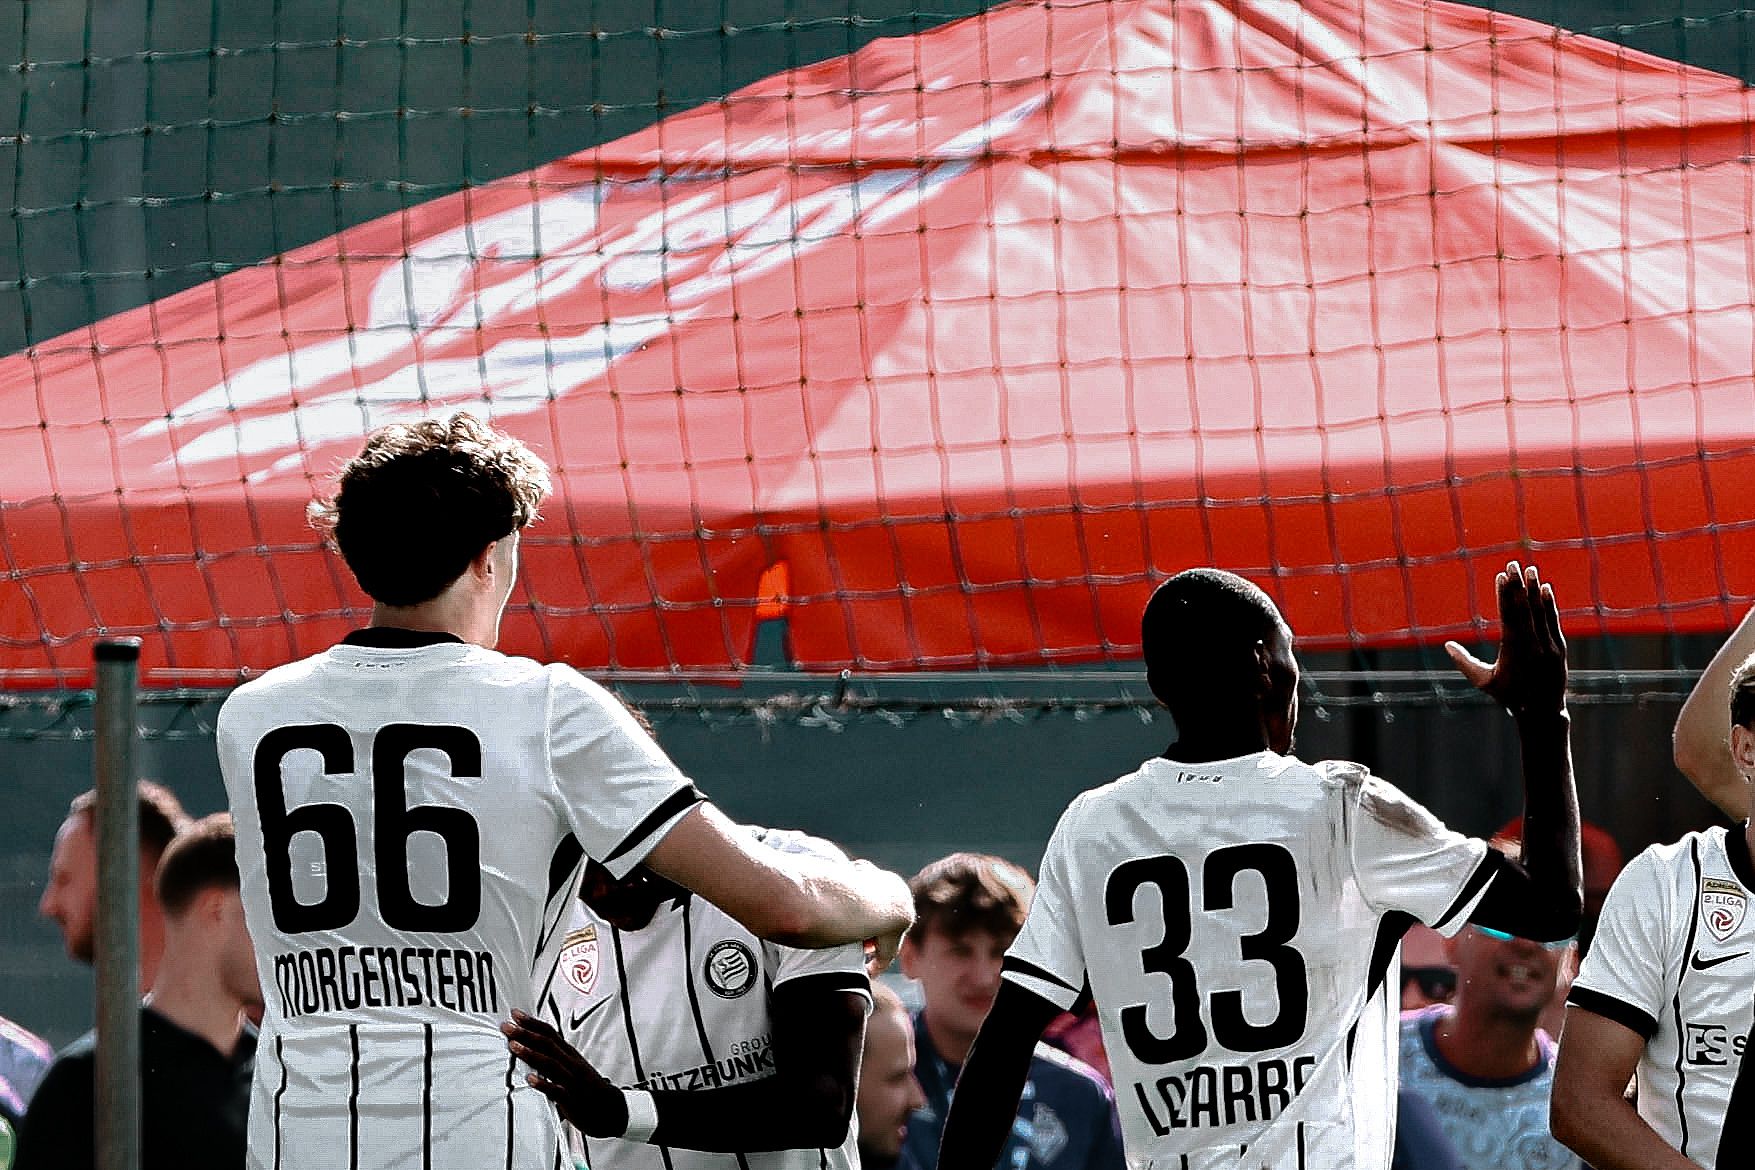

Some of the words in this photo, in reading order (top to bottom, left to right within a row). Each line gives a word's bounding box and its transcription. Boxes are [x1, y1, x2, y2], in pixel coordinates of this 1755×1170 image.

[253, 723, 482, 934] 66
[1715, 895, 1743, 909] LIGA
[275, 945, 498, 1019] MORGENSTERN
[1104, 843, 1310, 1065] 33
[730, 1032, 773, 1056] GROU
